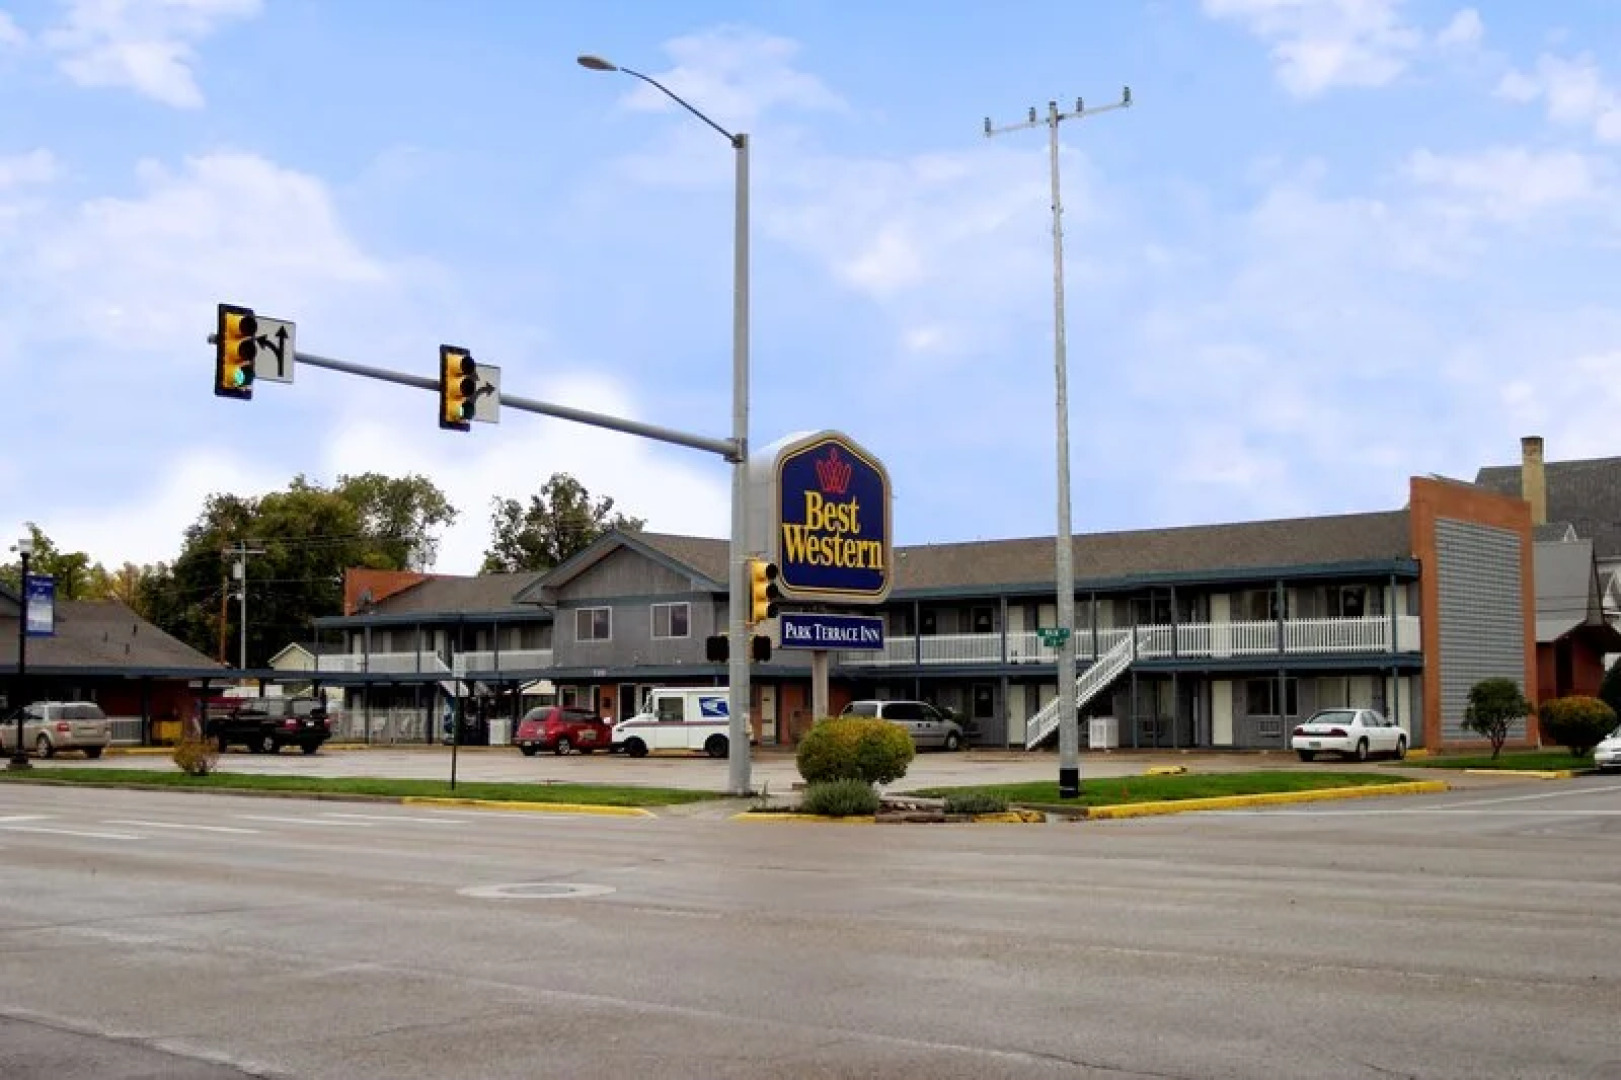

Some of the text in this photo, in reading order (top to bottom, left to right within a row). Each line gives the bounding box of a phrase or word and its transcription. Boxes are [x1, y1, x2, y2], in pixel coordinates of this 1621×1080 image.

[804, 490, 860, 534] Best
[782, 521, 883, 569] Western
[785, 622, 881, 642] PARK TERRACE INN
